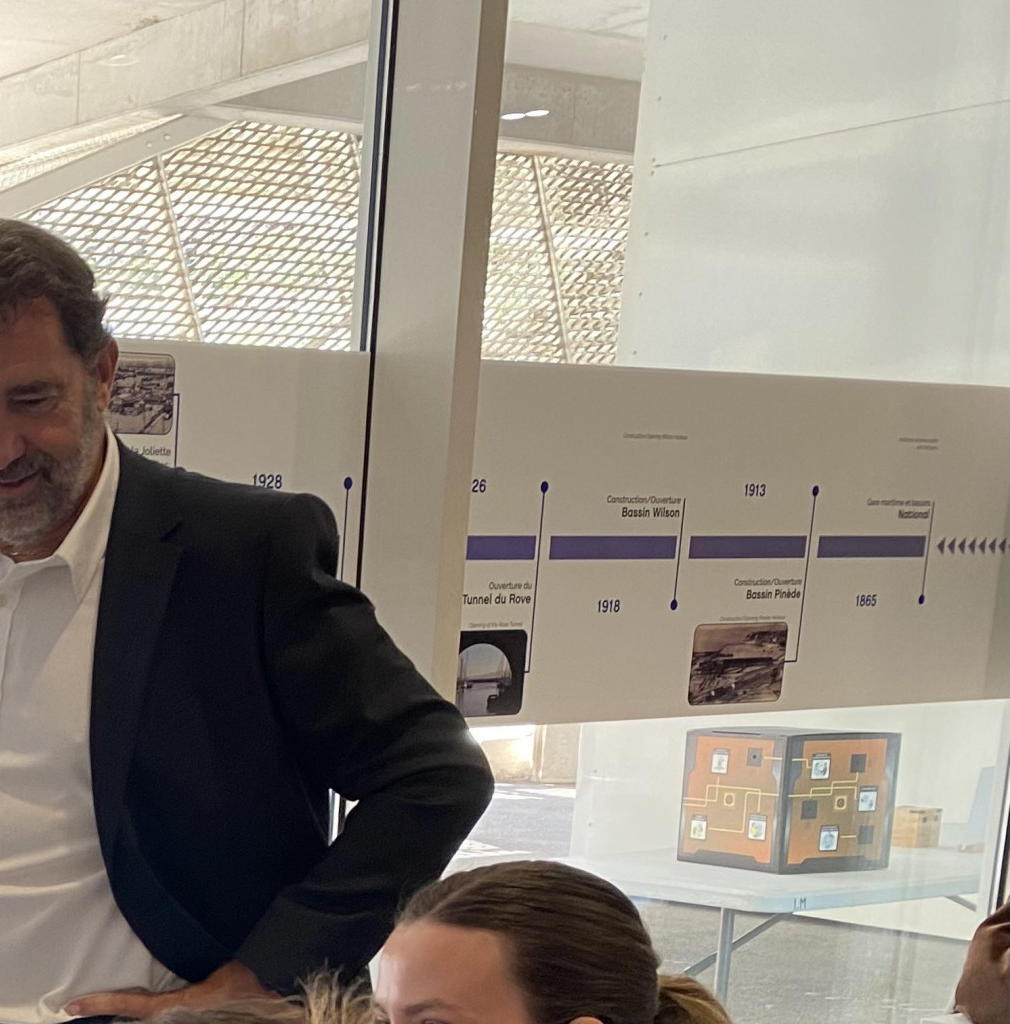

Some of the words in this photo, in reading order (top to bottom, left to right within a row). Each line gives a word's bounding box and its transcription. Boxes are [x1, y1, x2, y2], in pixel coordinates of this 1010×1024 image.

[252, 473, 283, 490] 1928
[471, 478, 487, 494] 26
[744, 483, 767, 497] 1913
[621, 506, 651, 519] Bassin
[652, 506, 681, 519] Wilson
[489, 581, 523, 590] Ouverture
[523, 581, 533, 590] du
[462, 593, 493, 605] Tunnel
[494, 593, 507, 605] du
[509, 593, 532, 604] Rove
[746, 588, 773, 600] Bassin
[774, 588, 801, 600] Pinède
[855, 593, 878, 607] 1865
[597, 599, 621, 613] 1918
